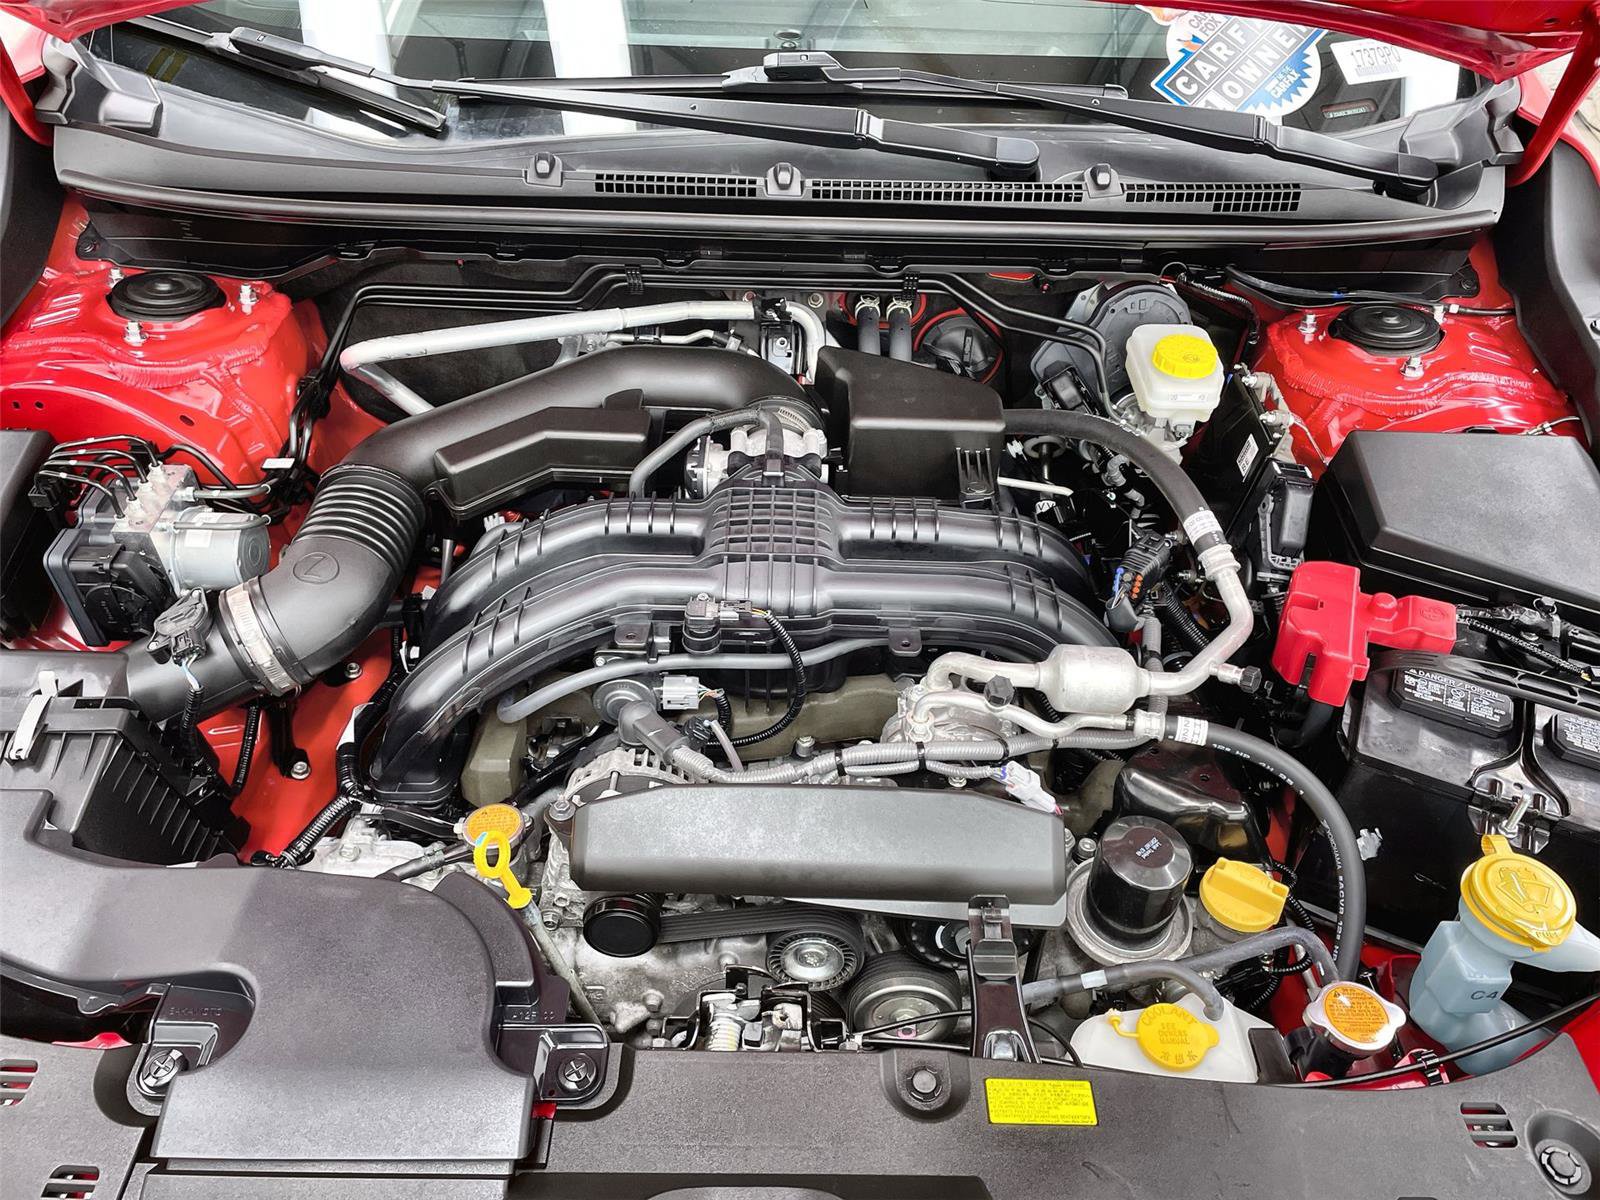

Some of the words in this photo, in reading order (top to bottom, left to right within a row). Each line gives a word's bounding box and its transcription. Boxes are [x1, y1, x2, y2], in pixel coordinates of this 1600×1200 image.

[1199, 16, 1221, 36] FOX
[1222, 23, 1307, 99] OWNE
[1418, 670, 1456, 687] DANGER
[1465, 683, 1499, 699] POISON
[1326, 828, 1342, 870] YOKOHAMA
[1470, 990, 1499, 1000] C4
[1141, 1005, 1197, 1026] COOLANT
